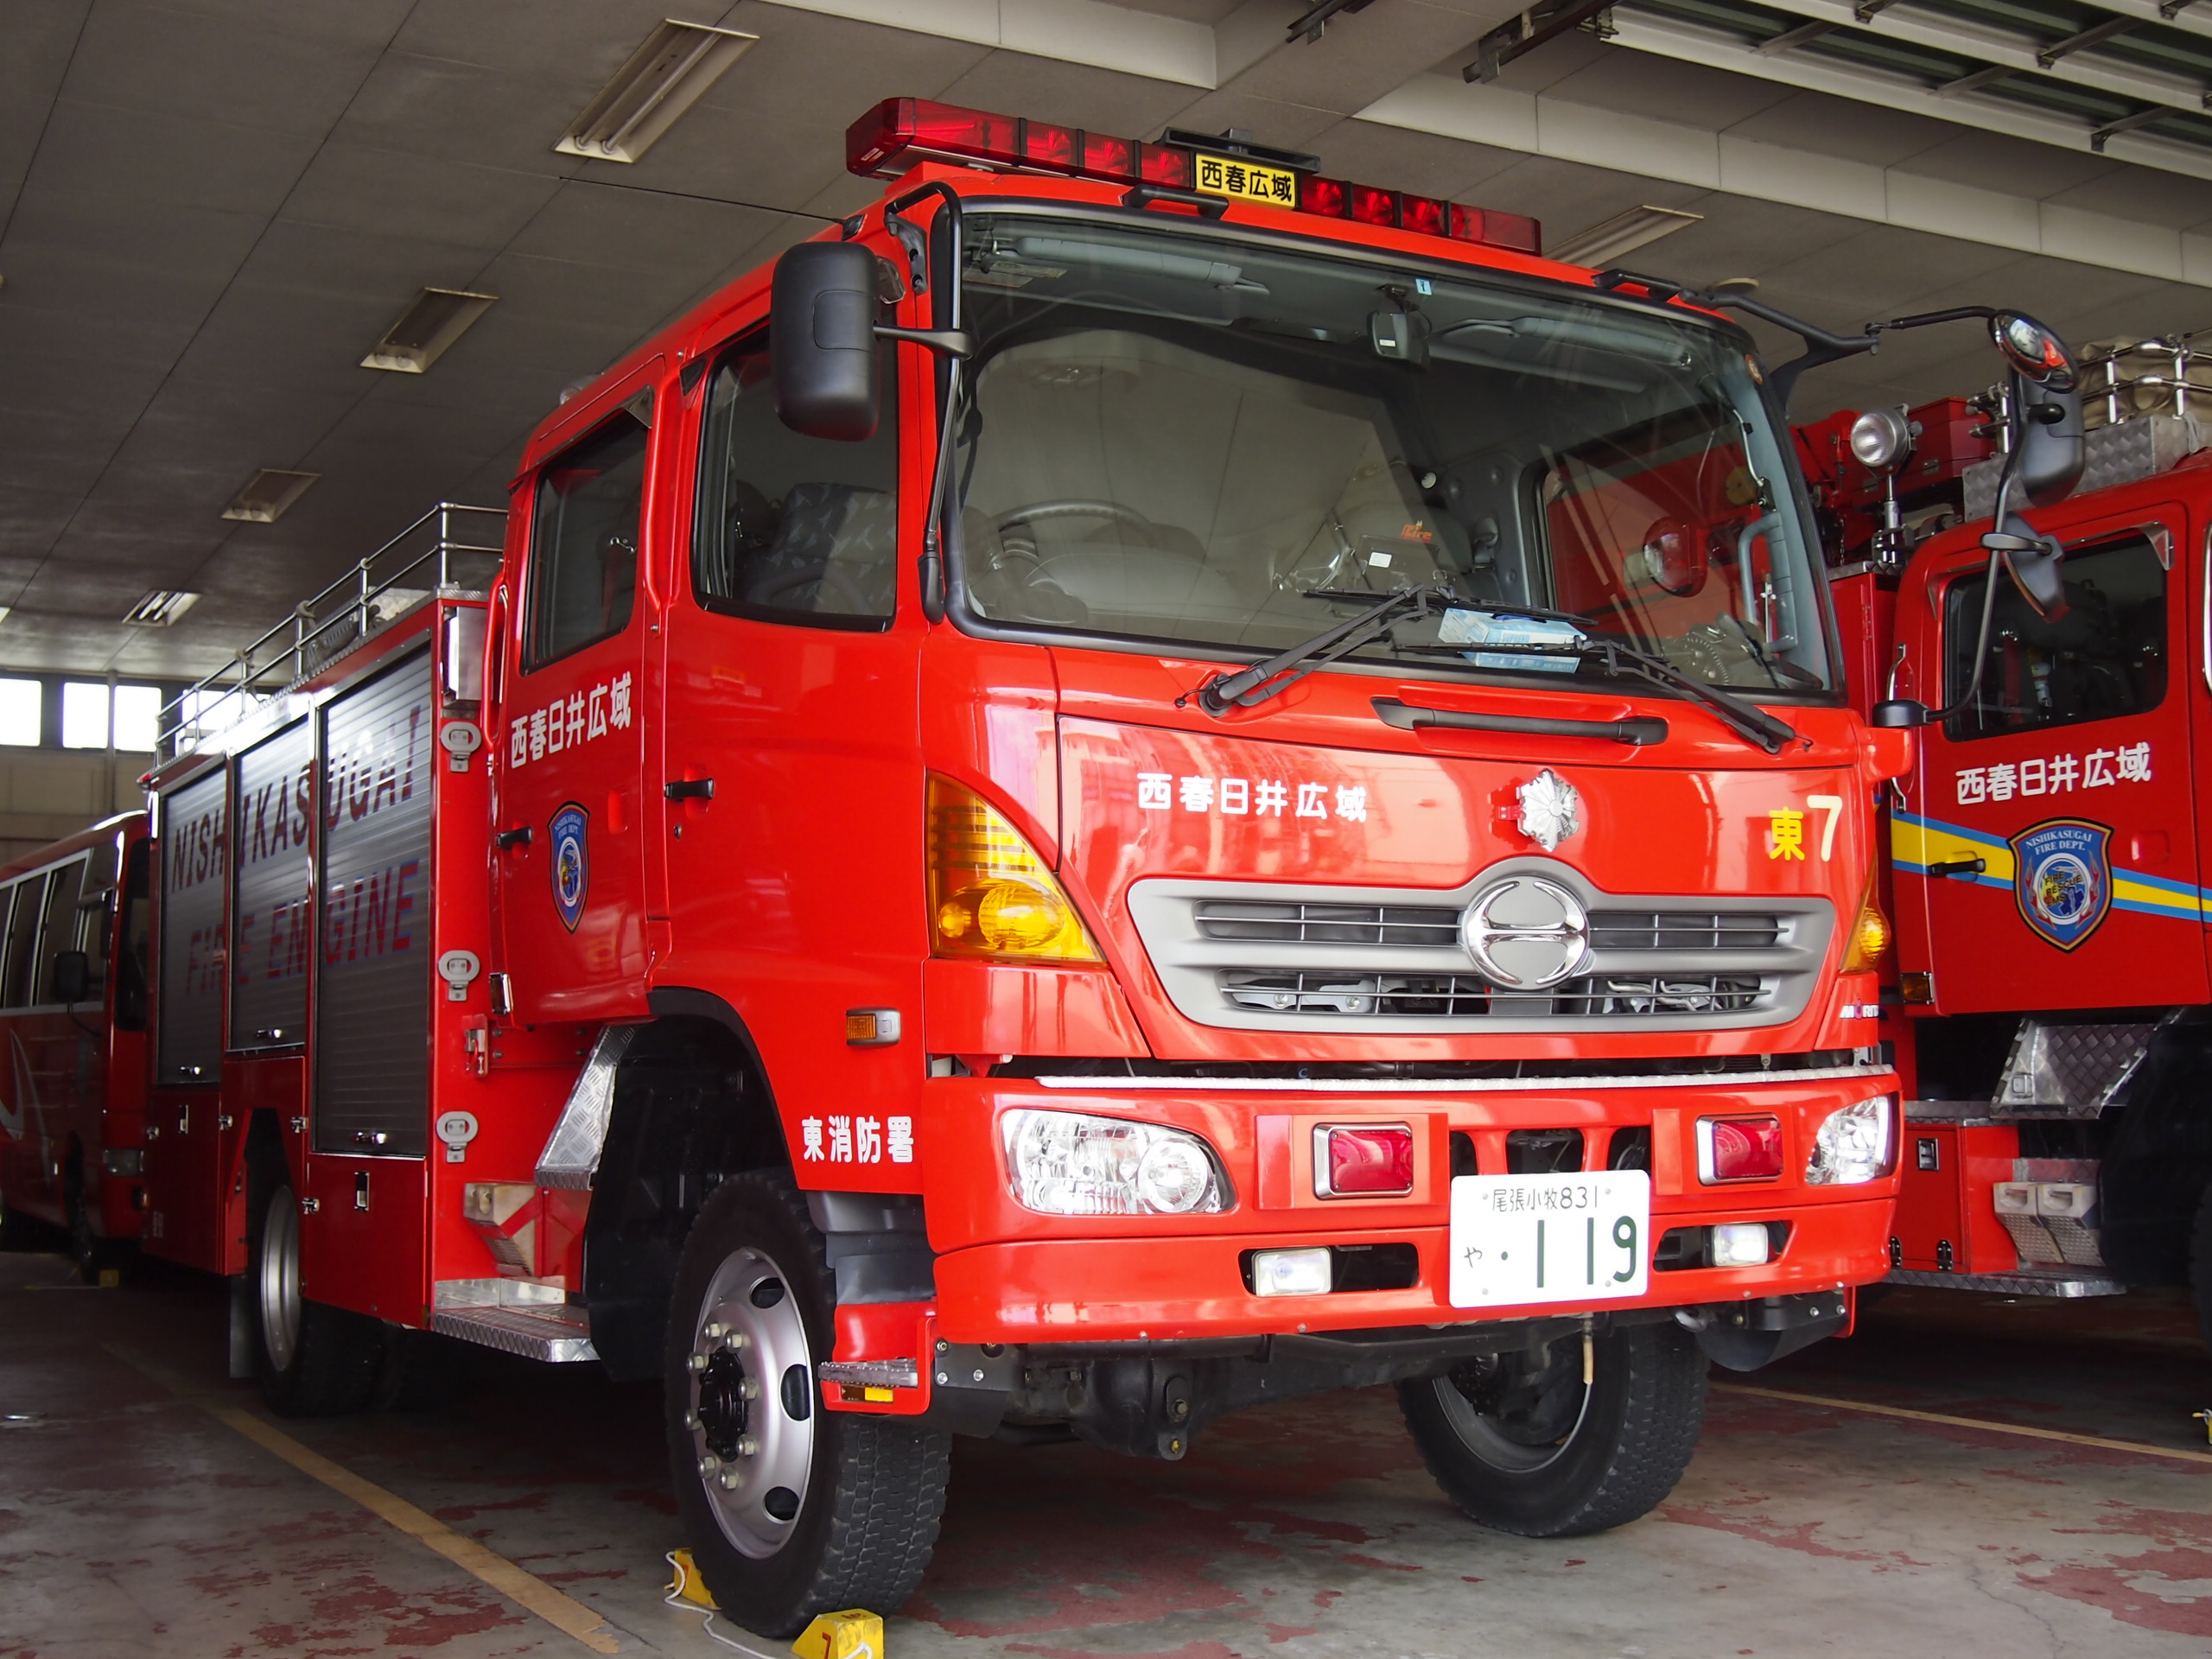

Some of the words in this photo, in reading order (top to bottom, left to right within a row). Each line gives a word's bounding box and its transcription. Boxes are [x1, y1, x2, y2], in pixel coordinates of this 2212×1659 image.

[1201, 159, 1292, 201] 西春広域
[511, 671, 632, 768] 西春日井広域
[1955, 741, 2152, 805] 西春日井広域
[1137, 772, 1367, 823] 西春日井広域
[2025, 830, 2093, 849] NISHIKASUGAI
[2035, 842, 2057, 855] FIRE
[2059, 840, 2086, 850] DEPT.
[2044, 871, 2065, 886] FIRE
[2046, 874, 2082, 896] RESCUE
[268, 858, 420, 980] ENGINE
[801, 1115, 914, 1164] 東消防署
